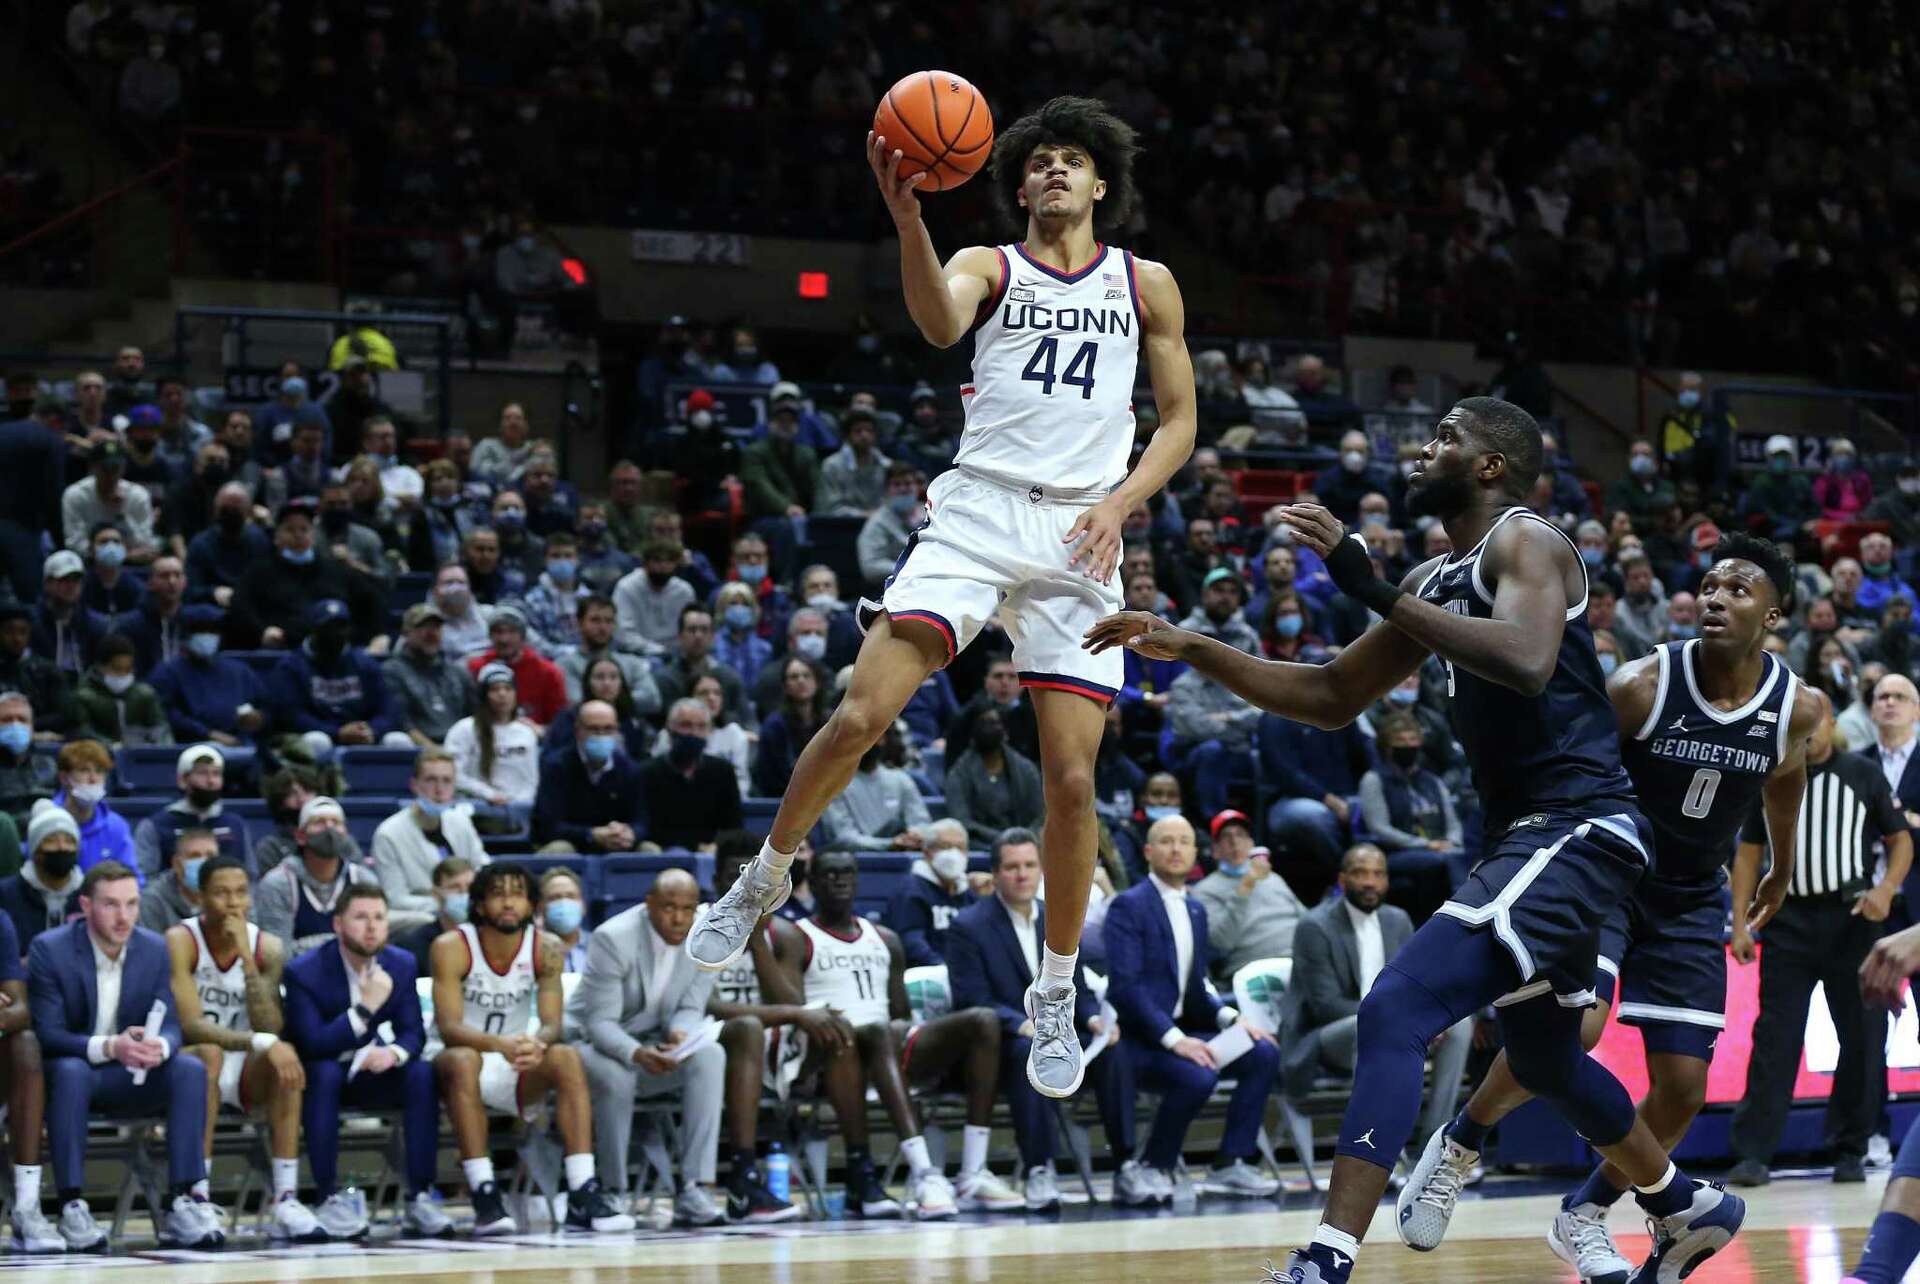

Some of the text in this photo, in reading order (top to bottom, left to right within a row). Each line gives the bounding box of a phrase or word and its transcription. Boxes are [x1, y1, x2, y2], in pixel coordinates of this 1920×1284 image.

[1002, 303, 1131, 338] UCONN
[1021, 336, 1099, 400] 44
[1650, 738, 1771, 774] GEORGETOWN
[1681, 767, 1722, 819] 0
[852, 969, 875, 1000] 11
